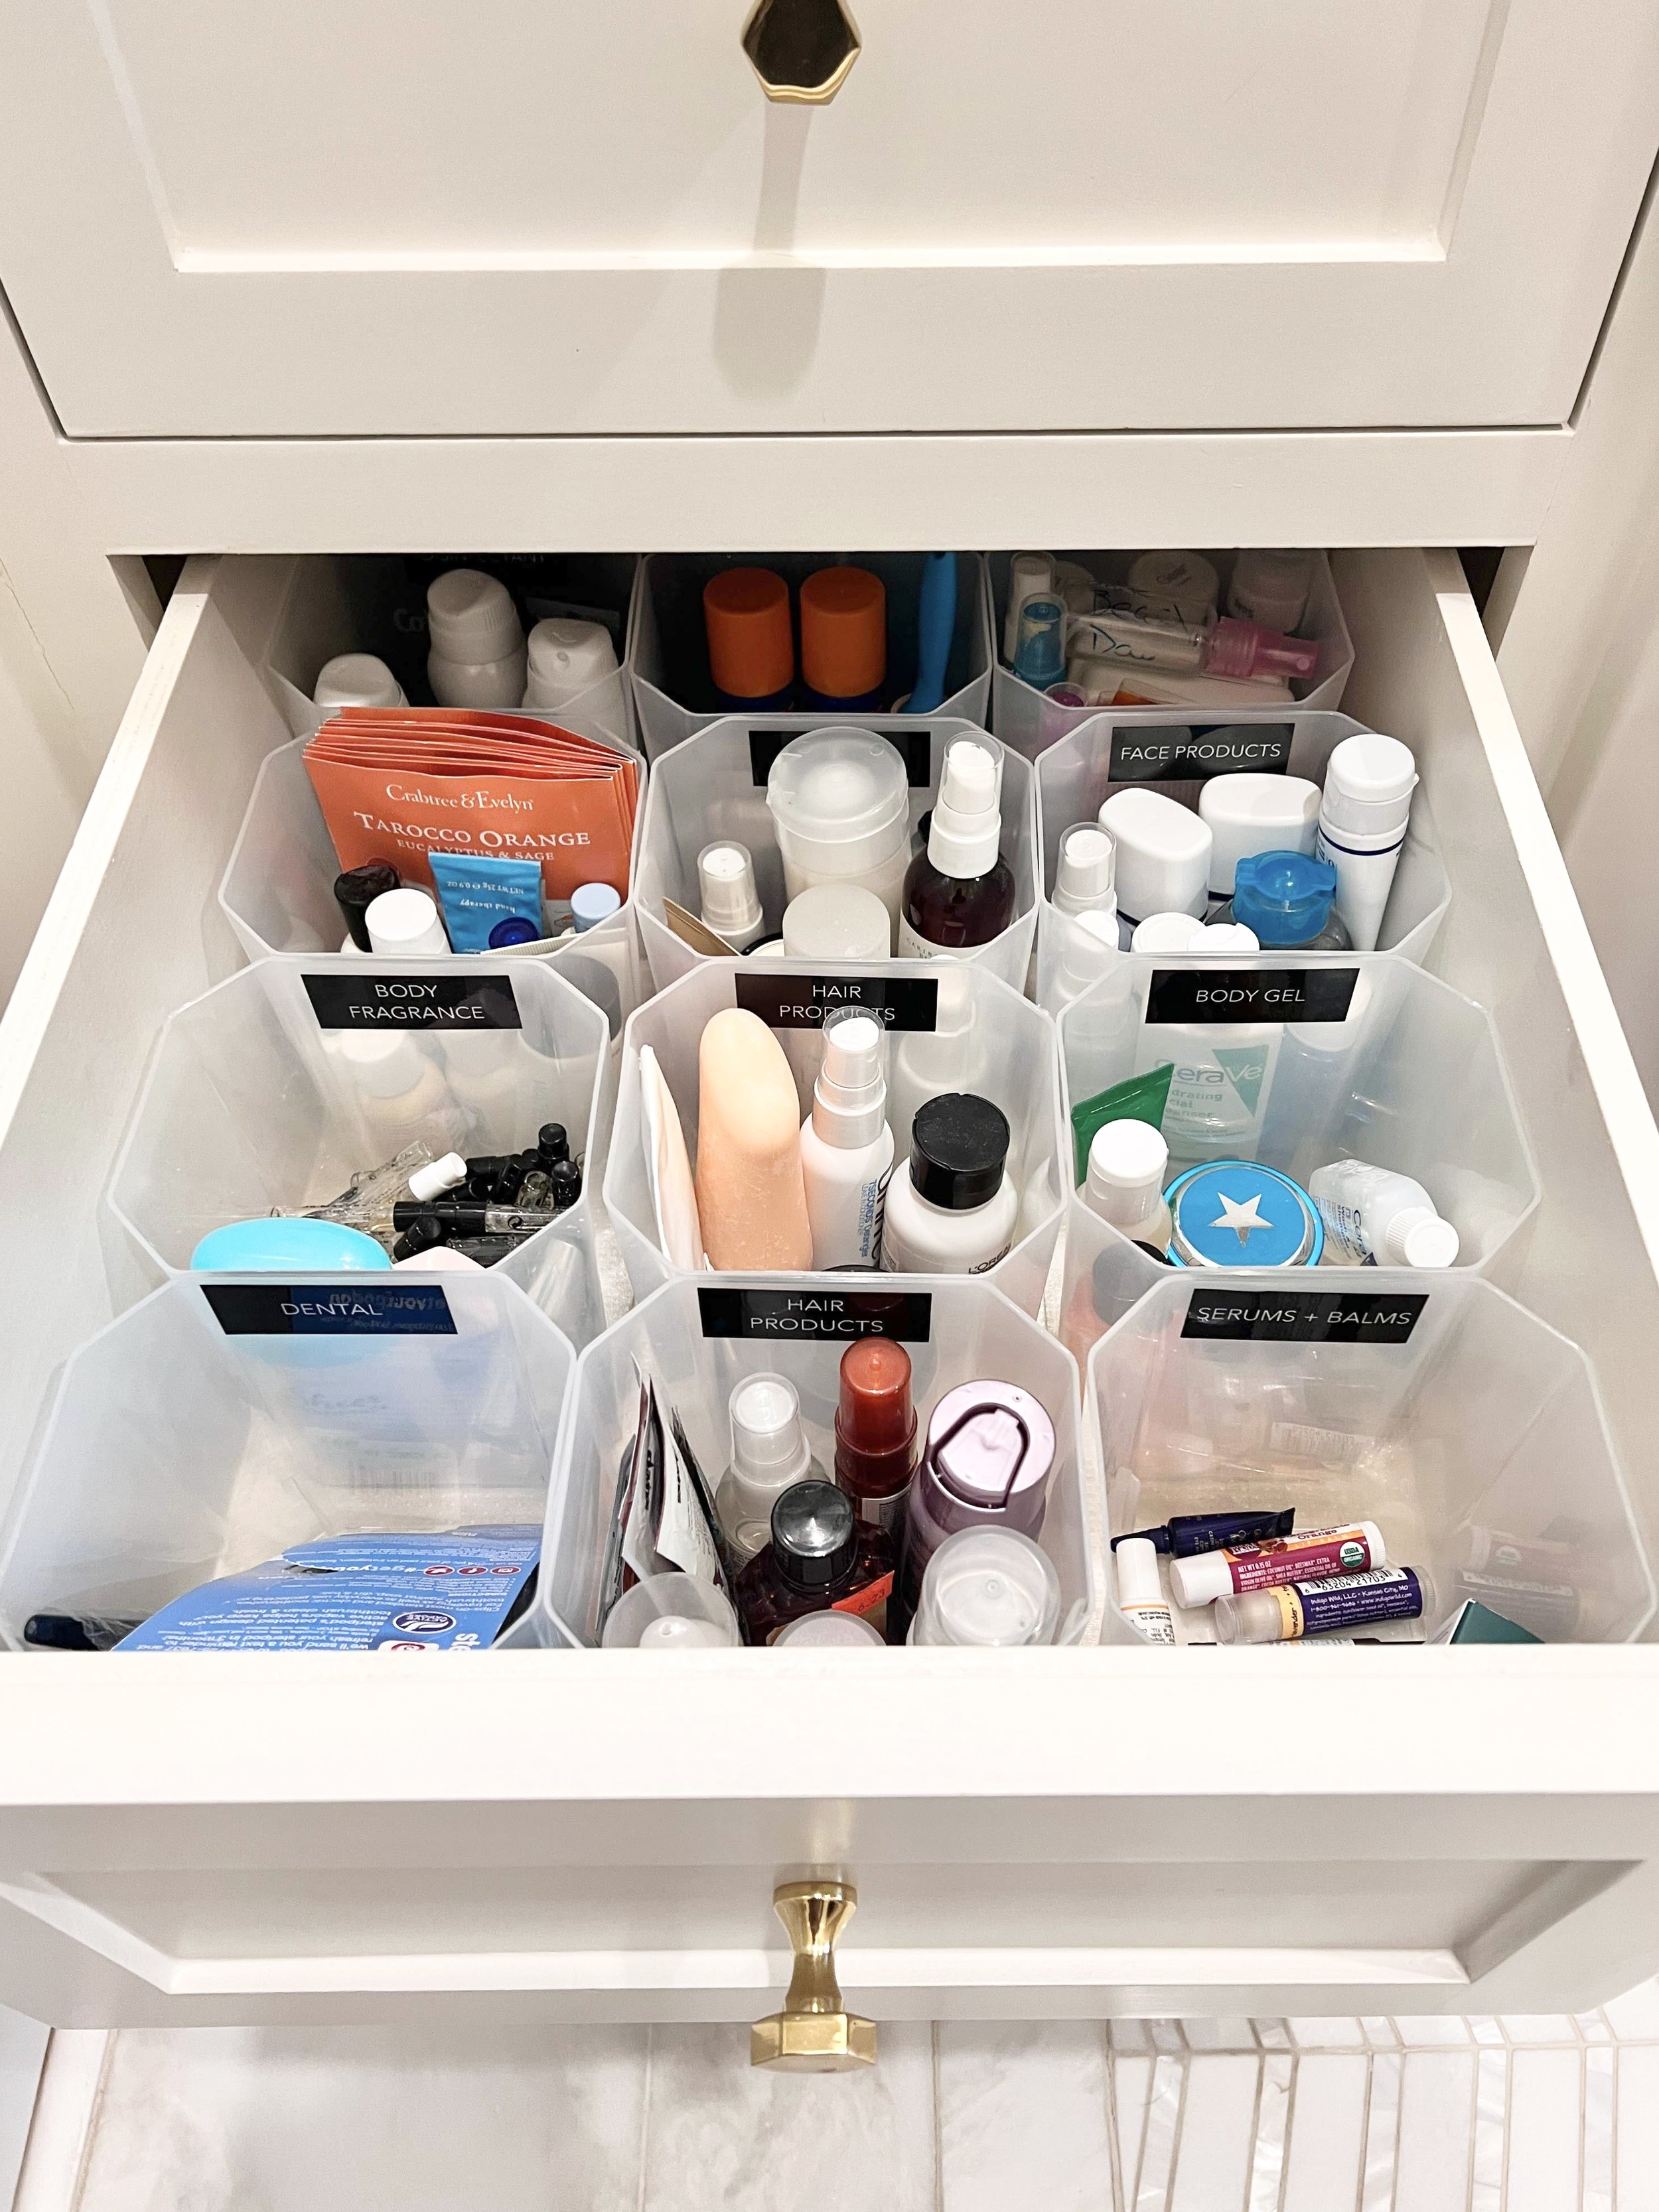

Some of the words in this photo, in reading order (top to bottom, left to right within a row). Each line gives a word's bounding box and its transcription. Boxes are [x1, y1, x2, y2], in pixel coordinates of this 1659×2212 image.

[1121, 746, 1171, 760] FACE
[1175, 744, 1281, 758] PRODUCTS
[386, 784, 458, 807] Crabtree
[461, 792, 474, 809] &
[475, 790, 534, 813] Evelyn
[354, 811, 471, 843] TAROCCO
[479, 830, 591, 847] ORANGE
[516, 851, 555, 861] SAGE
[482, 882, 495, 891] 25g
[460, 898, 493, 910] therapy
[496, 902, 516, 914] hand
[375, 985, 438, 999] BODY
[813, 985, 861, 998] HAIR
[1196, 990, 1260, 1002] BODY
[1264, 989, 1305, 1002] GEL
[348, 1005, 485, 1020] FRAGRANCE
[780, 1006, 895, 1020] PRODUCTS
[281, 1302, 383, 1316] DENTAL
[788, 1298, 843, 1312] HAIR
[1197, 1307, 1296, 1323] SERUMS
[1304, 1312, 1316, 1322] +
[1327, 1308, 1412, 1324] BALMS
[751, 1318, 883, 1332] PRODUCTS
[1317, 1557, 1331, 1566] EXTRA
[1342, 1554, 1363, 1562] ORGANIC
[1323, 1580, 1352, 1591] 63204
[1357, 1575, 1386, 1586] 21703
[1311, 1596, 1328, 1606] Indigo
